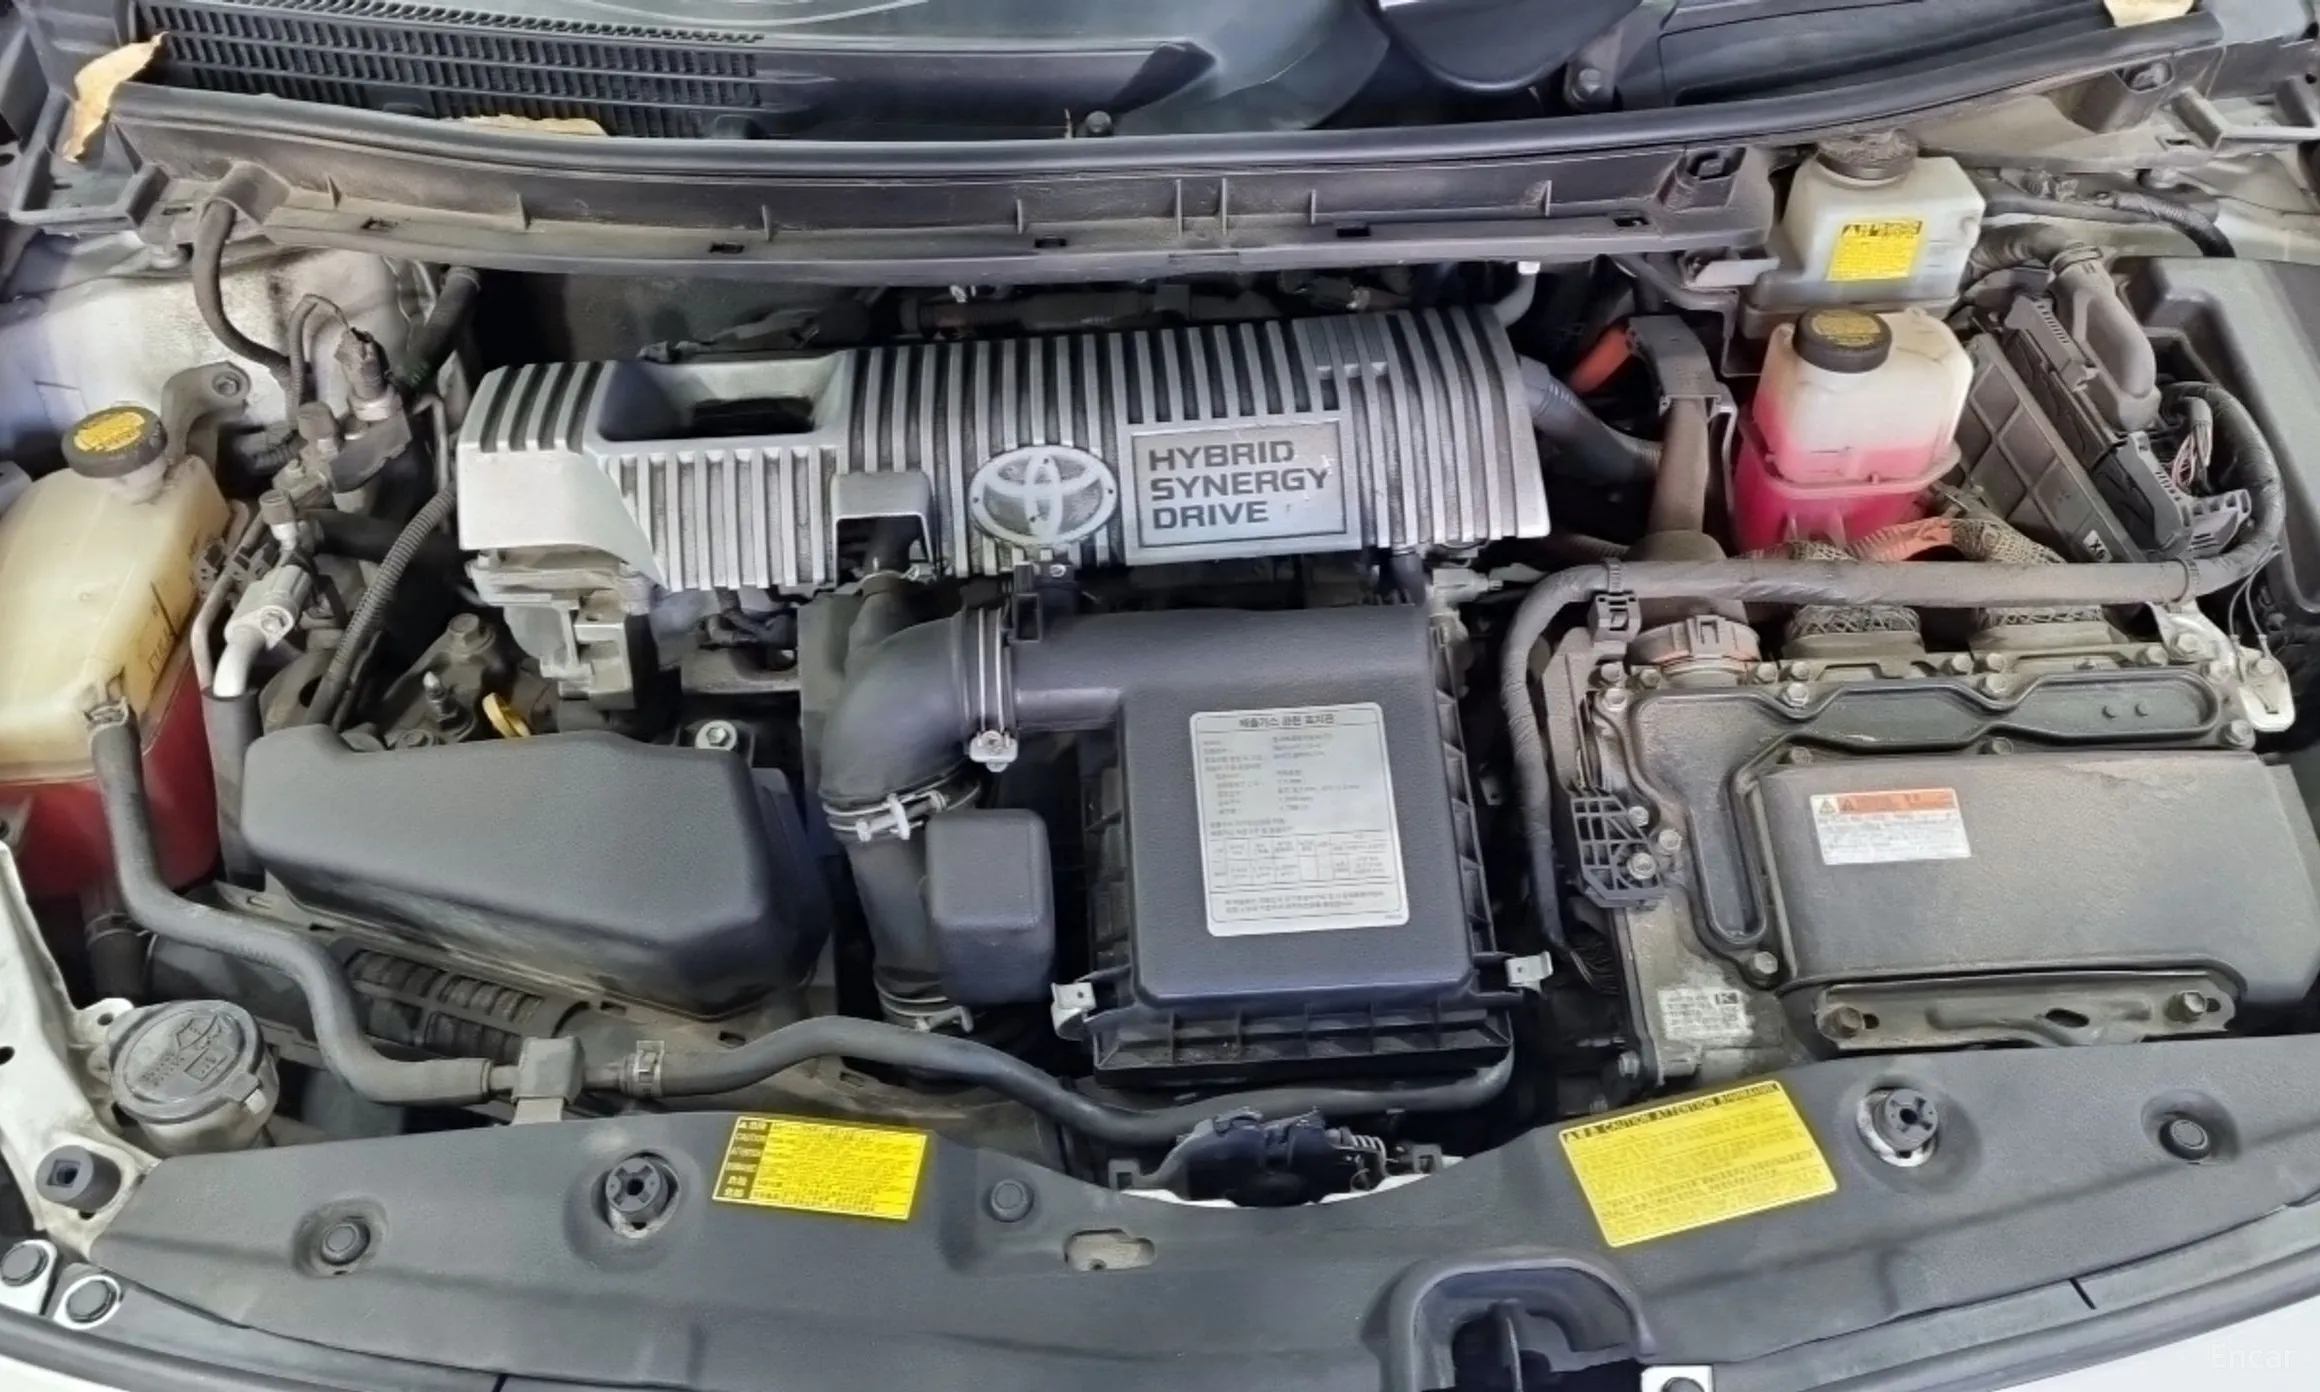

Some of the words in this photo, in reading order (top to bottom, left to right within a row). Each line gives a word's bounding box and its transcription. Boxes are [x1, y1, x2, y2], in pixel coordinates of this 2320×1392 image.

[1149, 440, 1295, 471] HYBRID
[1150, 467, 1328, 501] SYNERGY
[1153, 501, 1269, 530] DRIVE
